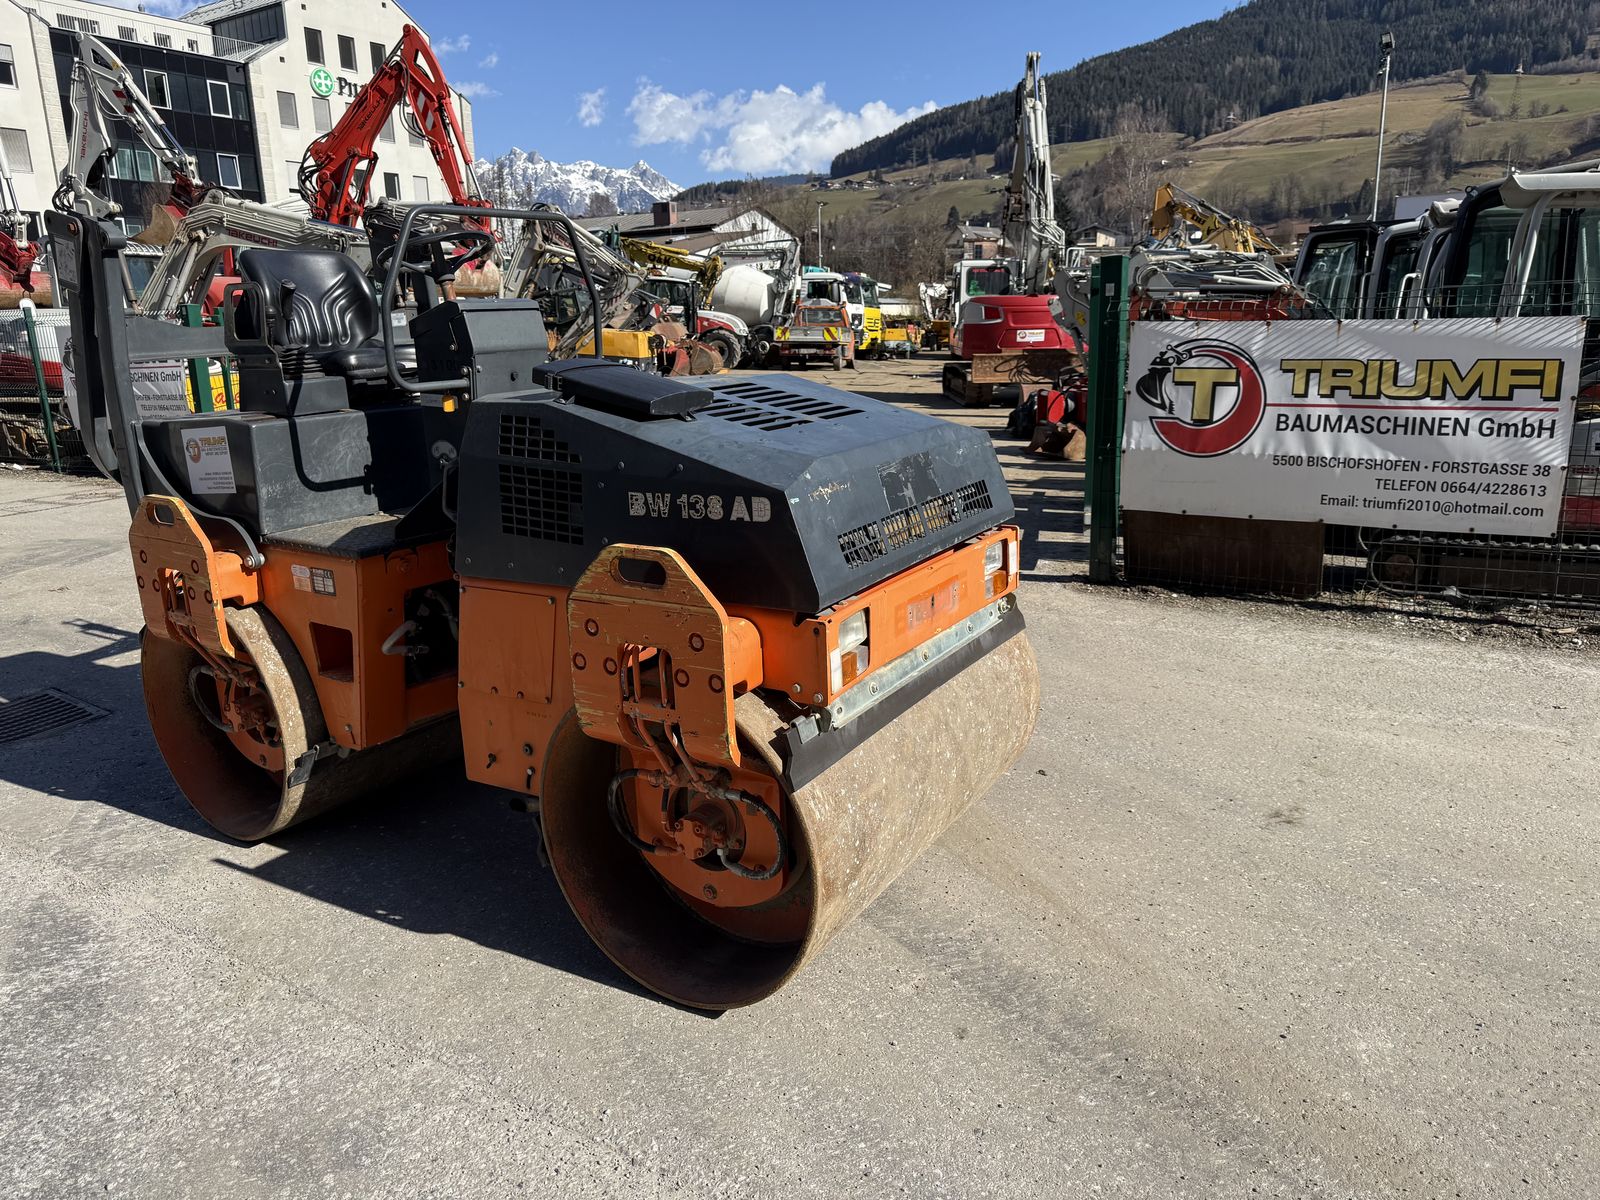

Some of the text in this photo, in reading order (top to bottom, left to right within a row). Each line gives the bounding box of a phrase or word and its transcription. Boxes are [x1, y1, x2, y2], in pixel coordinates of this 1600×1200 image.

[129, 370, 182, 383] SCHINEN GmbH
[1279, 358, 1565, 402] TRIUMFI
[1275, 413, 1557, 439] BAUMASCHINEN GmbH
[1272, 454, 1303, 467] 5500
[1306, 455, 1421, 473] BISCHOFSHOFEN
[1431, 460, 1529, 476] FORSTGASSE
[1532, 464, 1552, 477] 38
[1375, 478, 1548, 497] TELEFON 0664/4228613
[628, 491, 772, 523] BW 138 AD
[1320, 494, 1545, 518] Email: triumfi2010@hotmail.com
